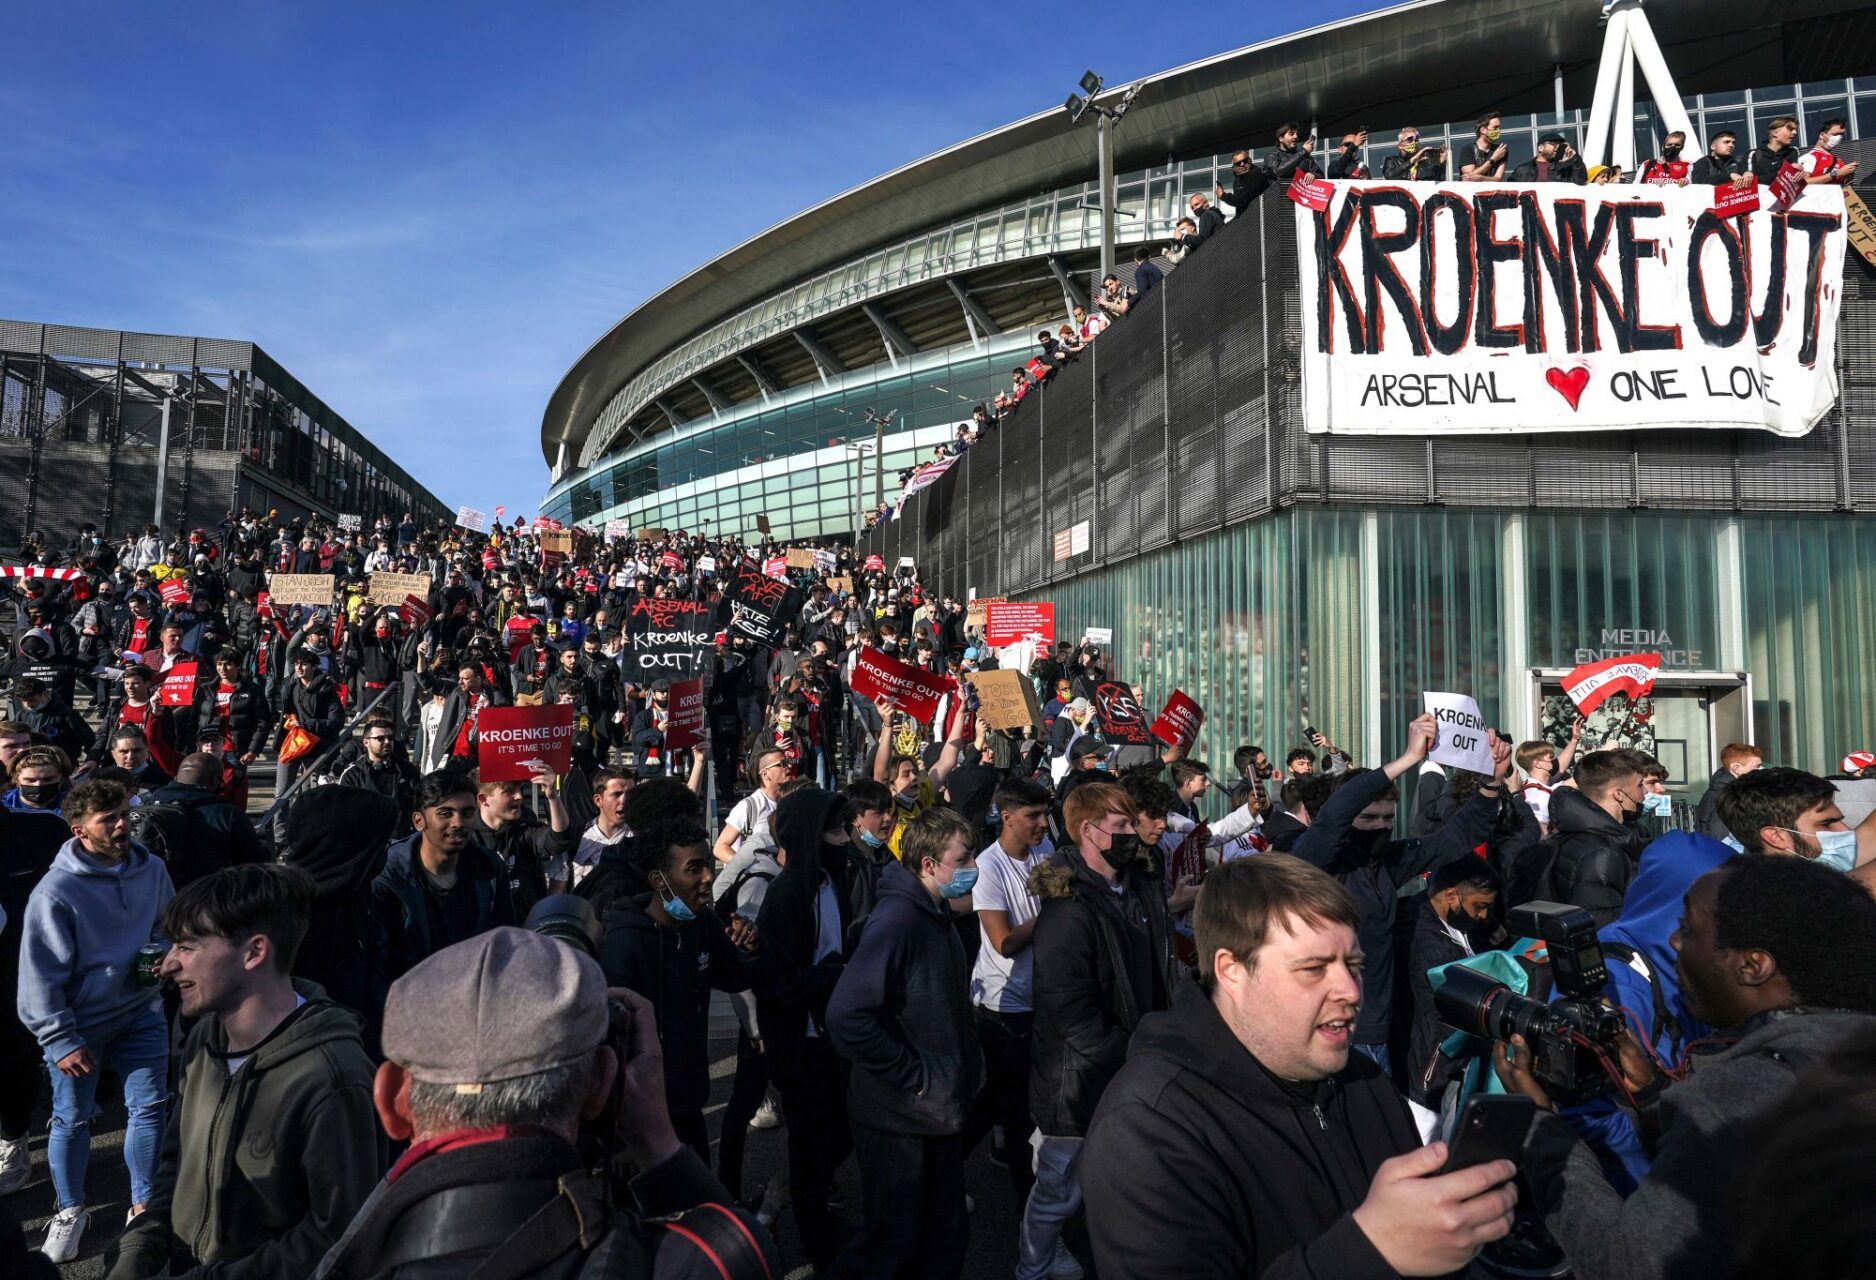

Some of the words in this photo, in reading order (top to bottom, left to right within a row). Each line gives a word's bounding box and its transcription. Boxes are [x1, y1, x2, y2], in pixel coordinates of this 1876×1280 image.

[1313, 186, 1684, 357] KROENKE
[1687, 207, 1842, 368] OUT
[1361, 371, 1516, 407] ARSENAL
[1610, 369, 1687, 402] ONE
[1704, 366, 1782, 406] LOVE
[739, 565, 787, 594] LOVE
[632, 598, 708, 616] ARSENAL
[741, 585, 776, 608] AFC
[652, 613, 675, 628] FC
[1601, 629, 1672, 645] MEDIA
[1574, 648, 1703, 665] ENTNCE
[858, 658, 914, 689] KROENKE
[916, 684, 942, 701] OUT
[868, 675, 881, 686] IT'S
[882, 683, 899, 694] TIME
[900, 688, 911, 697] TO
[912, 692, 924, 702] GO
[1433, 707, 1487, 733] KROENK
[479, 726, 551, 744] KROENKE
[552, 725, 573, 738] OUT
[1452, 734, 1478, 752] OUT
[498, 745, 515, 754] IT'S
[518, 744, 539, 753] TIME
[540, 743, 550, 751] TO
[551, 742, 562, 750] GO
